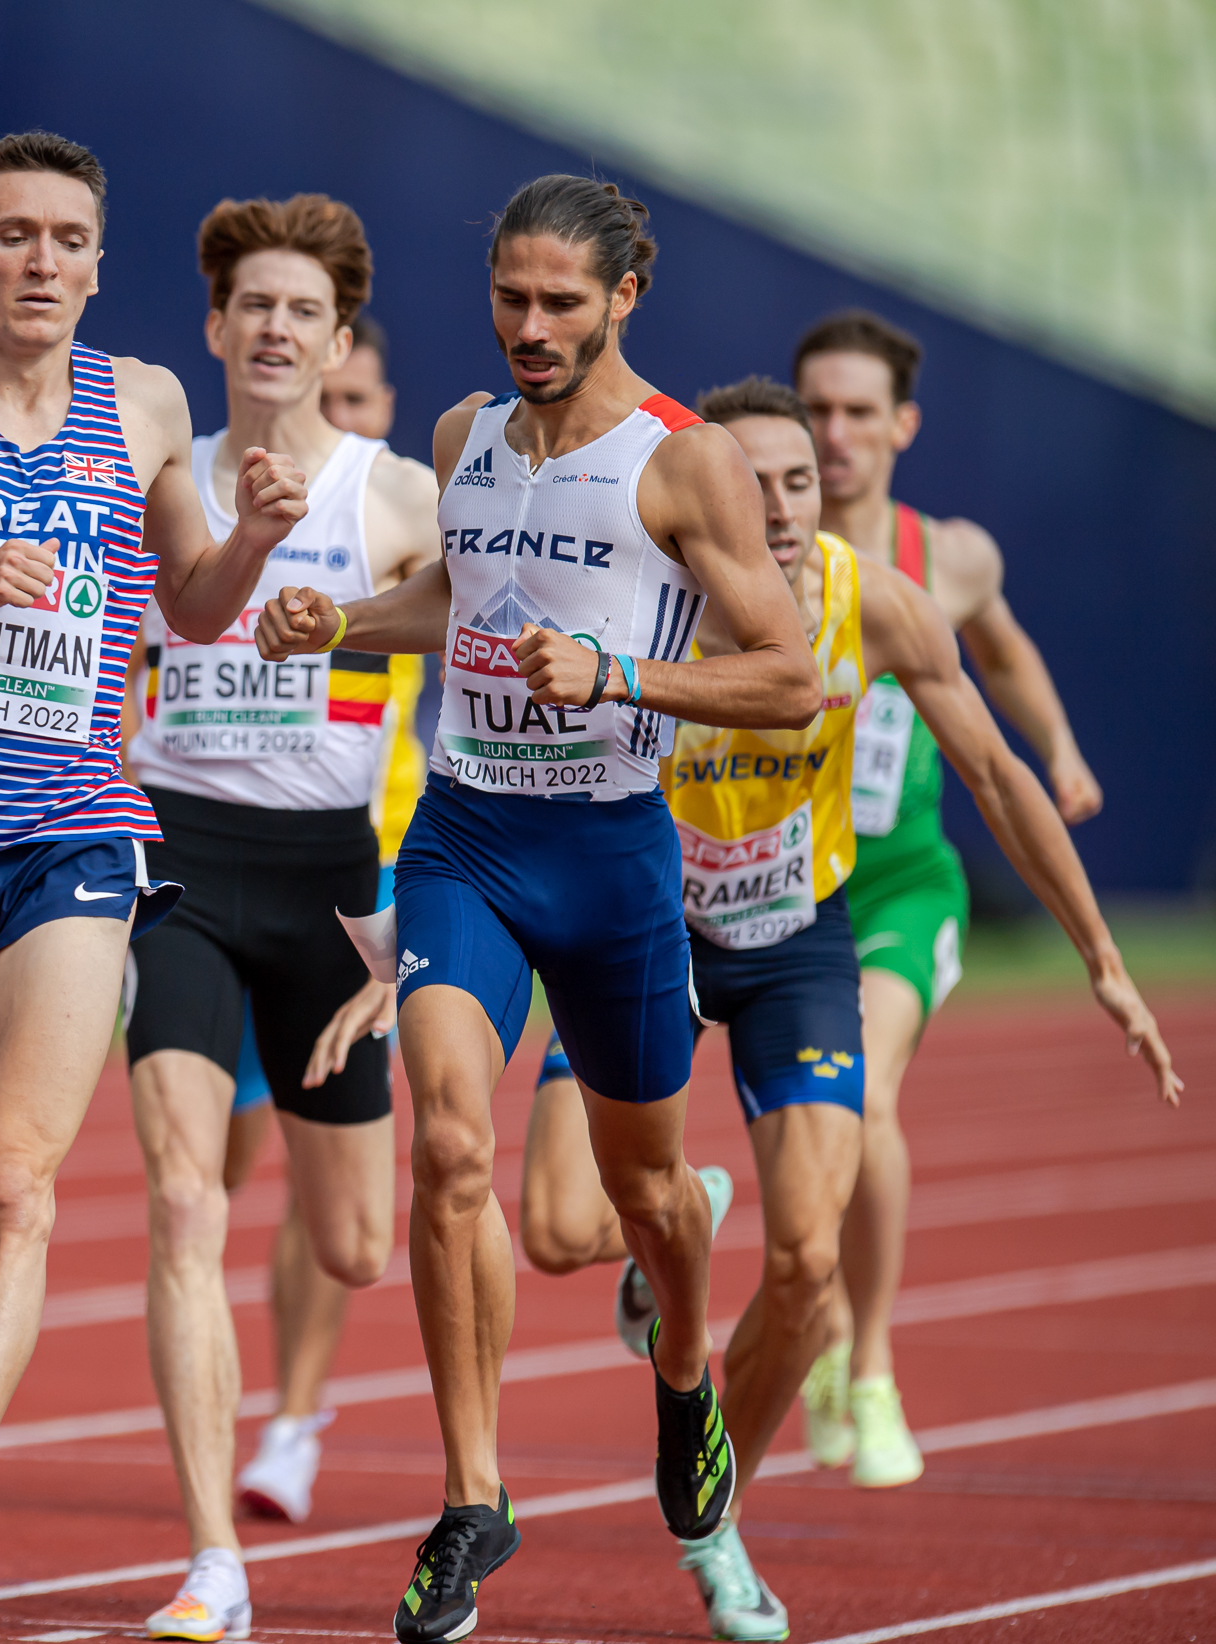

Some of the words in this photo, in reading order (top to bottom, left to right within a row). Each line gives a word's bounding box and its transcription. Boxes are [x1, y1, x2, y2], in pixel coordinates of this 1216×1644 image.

[454, 471, 496, 489] adidas
[552, 474, 578, 484] Crédit
[588, 475, 620, 485] Mutuel
[444, 528, 614, 569] FRANCE
[454, 633, 523, 673] SPA
[164, 664, 201, 702] DE
[215, 662, 321, 699] SMET
[18, 704, 79, 733] 2022
[461, 687, 587, 735] TUAL
[163, 729, 249, 754] MUNICH
[257, 729, 316, 753] 2022
[483, 743, 513, 758] RUN
[446, 755, 536, 788] MUNICH
[545, 763, 607, 787] 2022
[673, 747, 829, 790] SWEDEN
[682, 856, 805, 912] RAMER
